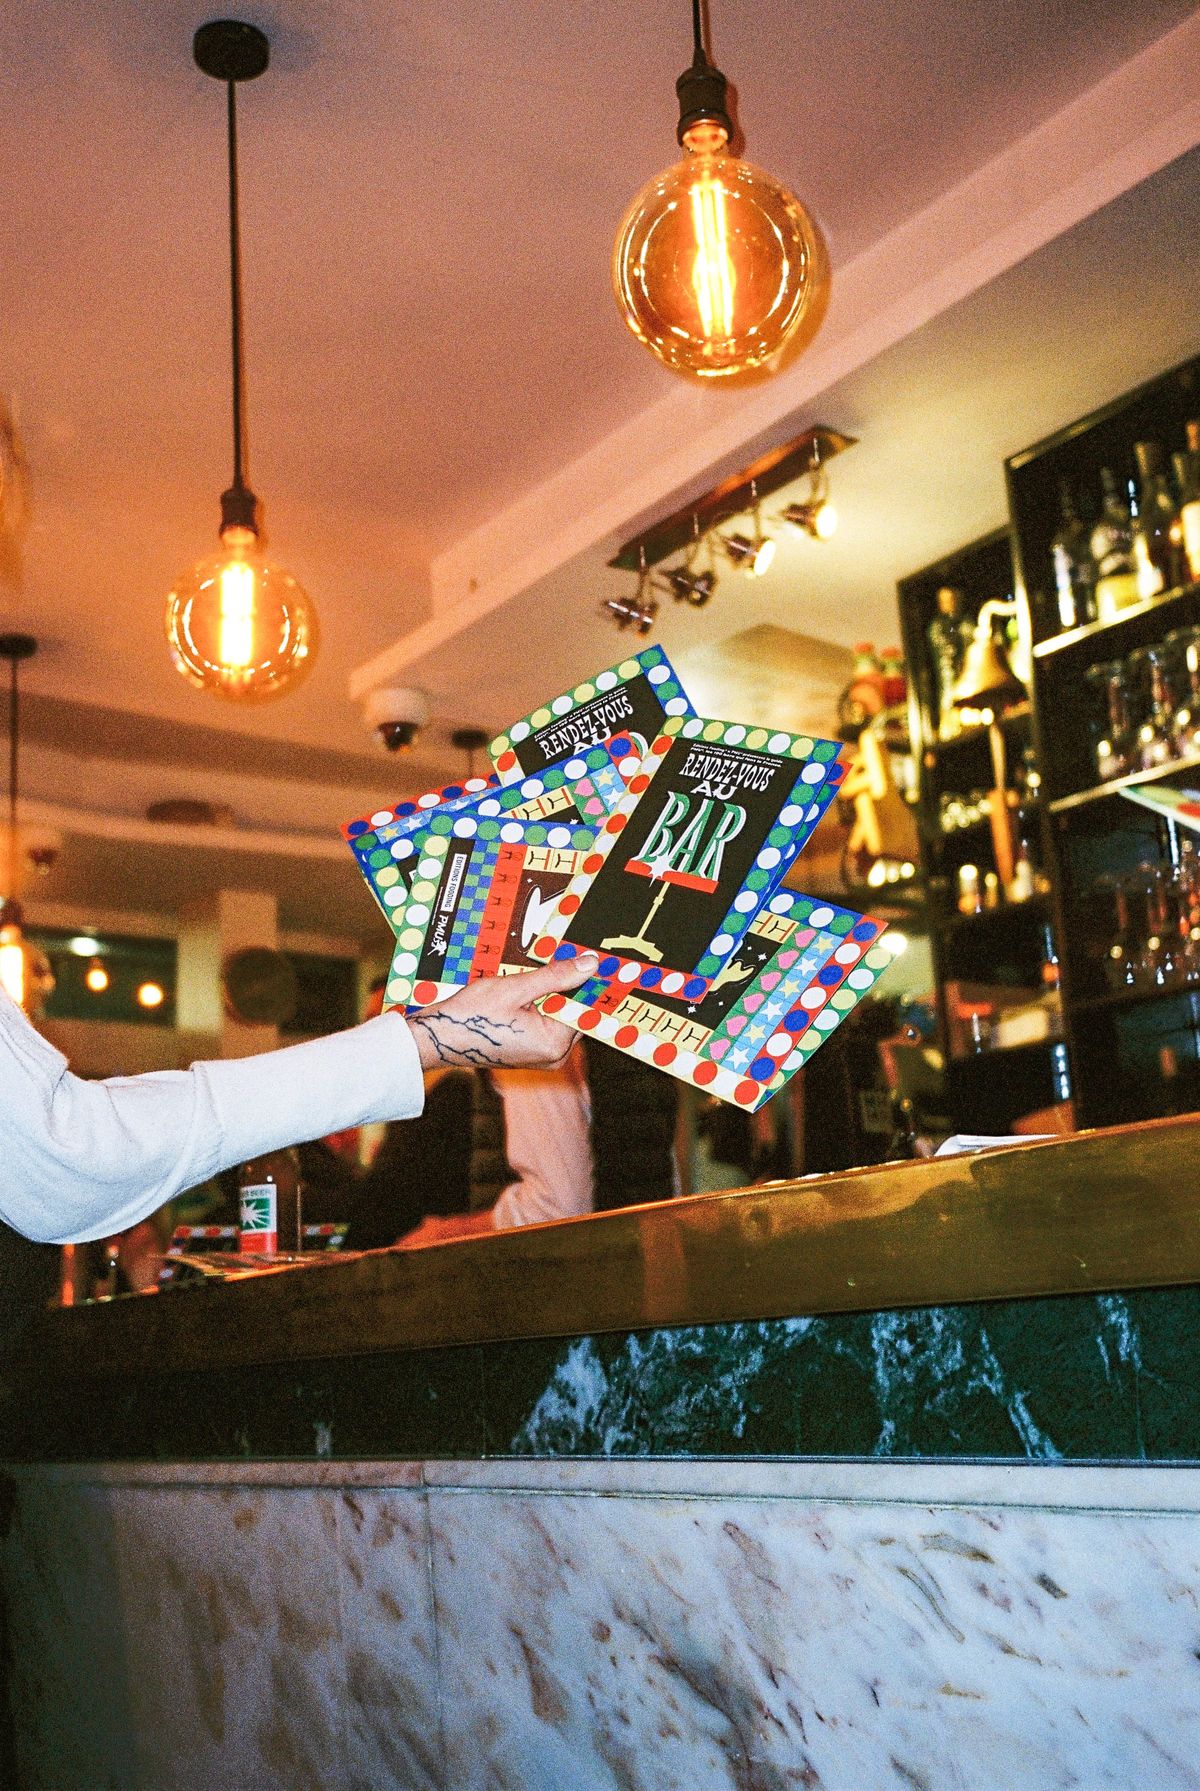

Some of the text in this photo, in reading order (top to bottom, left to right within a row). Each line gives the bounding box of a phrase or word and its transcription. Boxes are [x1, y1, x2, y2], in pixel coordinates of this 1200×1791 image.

[539, 695, 634, 760] RENDEZ-VOUS
[679, 753, 776, 792] RENDEZ-VOUS
[690, 780, 738, 800] AU
[629, 791, 747, 881] BAR
